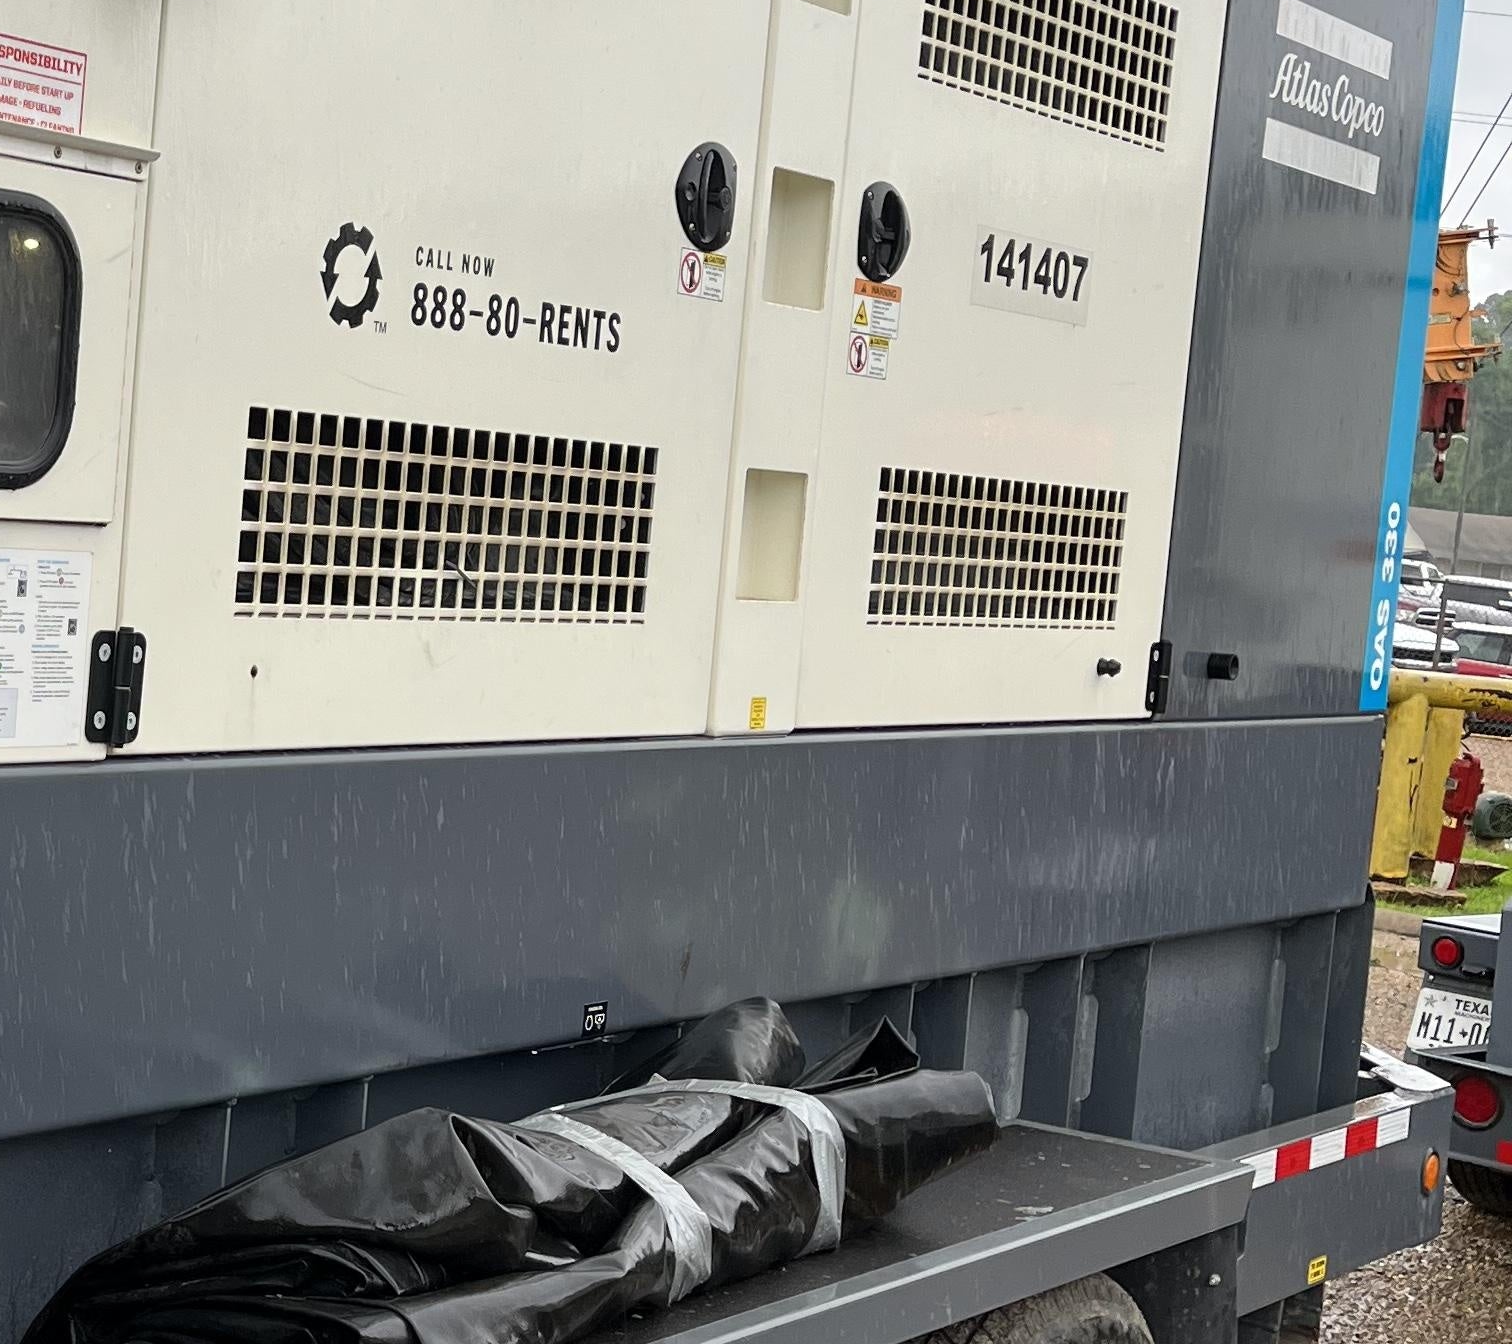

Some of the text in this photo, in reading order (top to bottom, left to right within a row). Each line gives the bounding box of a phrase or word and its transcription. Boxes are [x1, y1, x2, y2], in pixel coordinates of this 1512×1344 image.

[13, 80, 40, 94] BEFORE
[41, 86, 63, 99] START
[64, 91, 74, 101] UP
[23, 99, 62, 116] REFUELING
[415, 246, 496, 278] CALL NOW
[980, 233, 1089, 302] 141407
[373, 320, 388, 335] TM
[411, 282, 622, 353] 888-80-RENTS
[1381, 501, 1402, 584] 330
[1455, 998, 1489, 1016] TEXA
